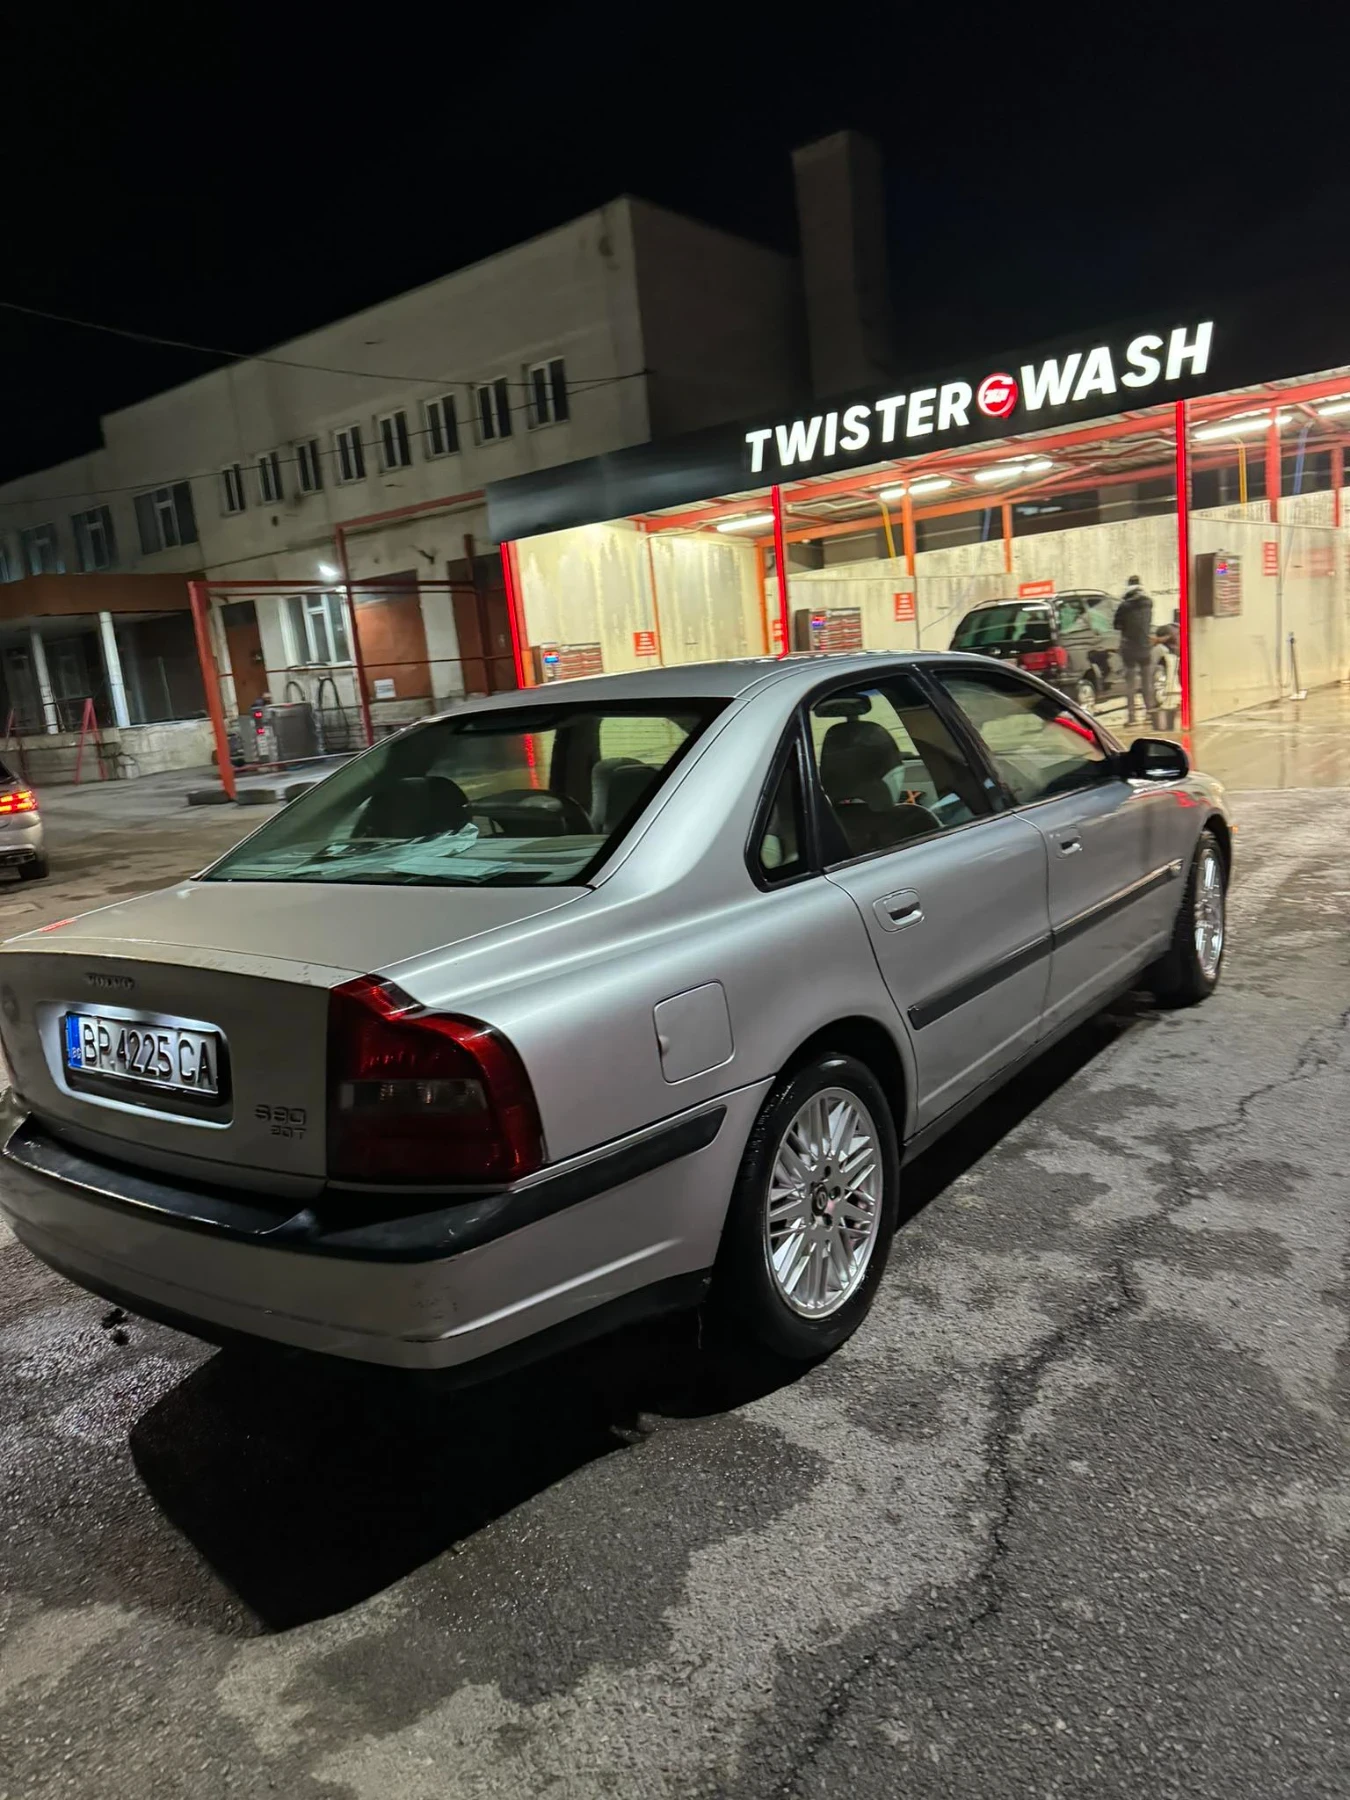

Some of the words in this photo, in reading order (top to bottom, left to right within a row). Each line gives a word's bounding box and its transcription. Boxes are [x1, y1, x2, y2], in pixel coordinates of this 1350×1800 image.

[745, 381, 971, 472] TWISTER
[1020, 322, 1213, 410] WASH
[84, 1022, 112, 1064] BP
[117, 1028, 174, 1078] 4225
[178, 1037, 213, 1086] CA
